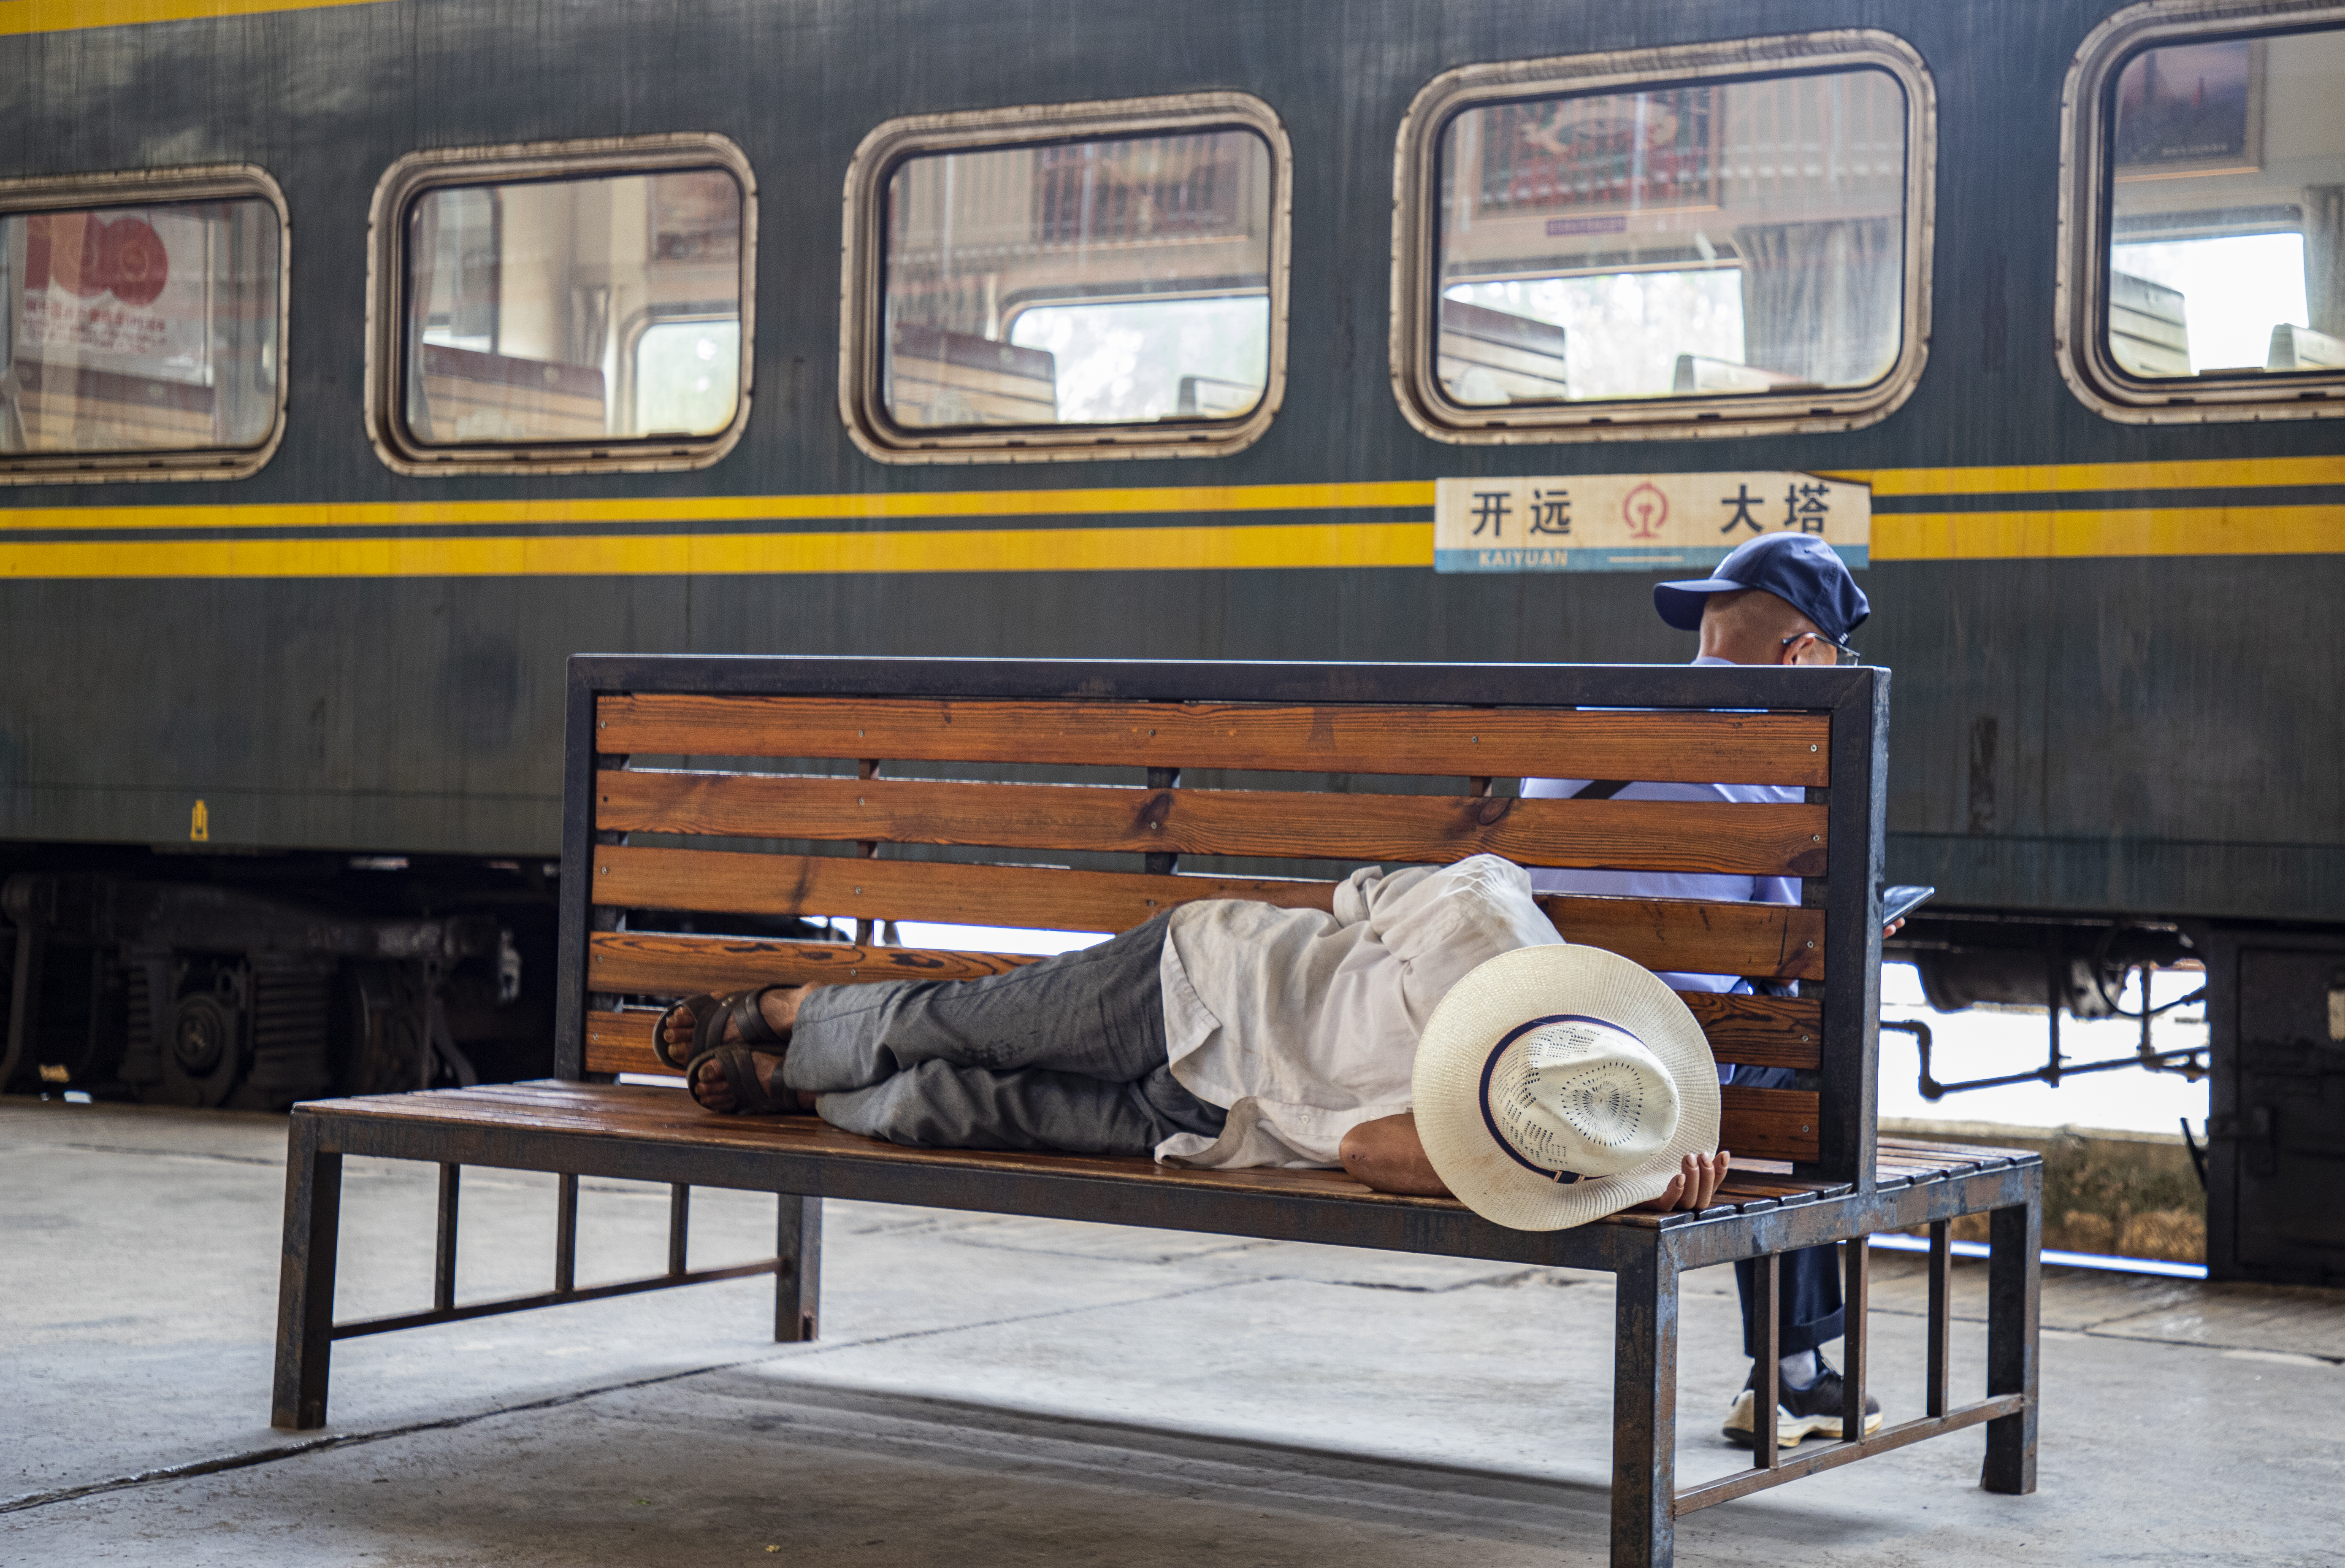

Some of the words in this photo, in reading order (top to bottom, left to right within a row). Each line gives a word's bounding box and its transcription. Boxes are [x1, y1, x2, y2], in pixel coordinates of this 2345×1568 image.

[1471, 488, 1571, 536] 开远
[1720, 483, 1830, 534] 大塔
[1479, 550, 1568, 567] KAIYUAN
